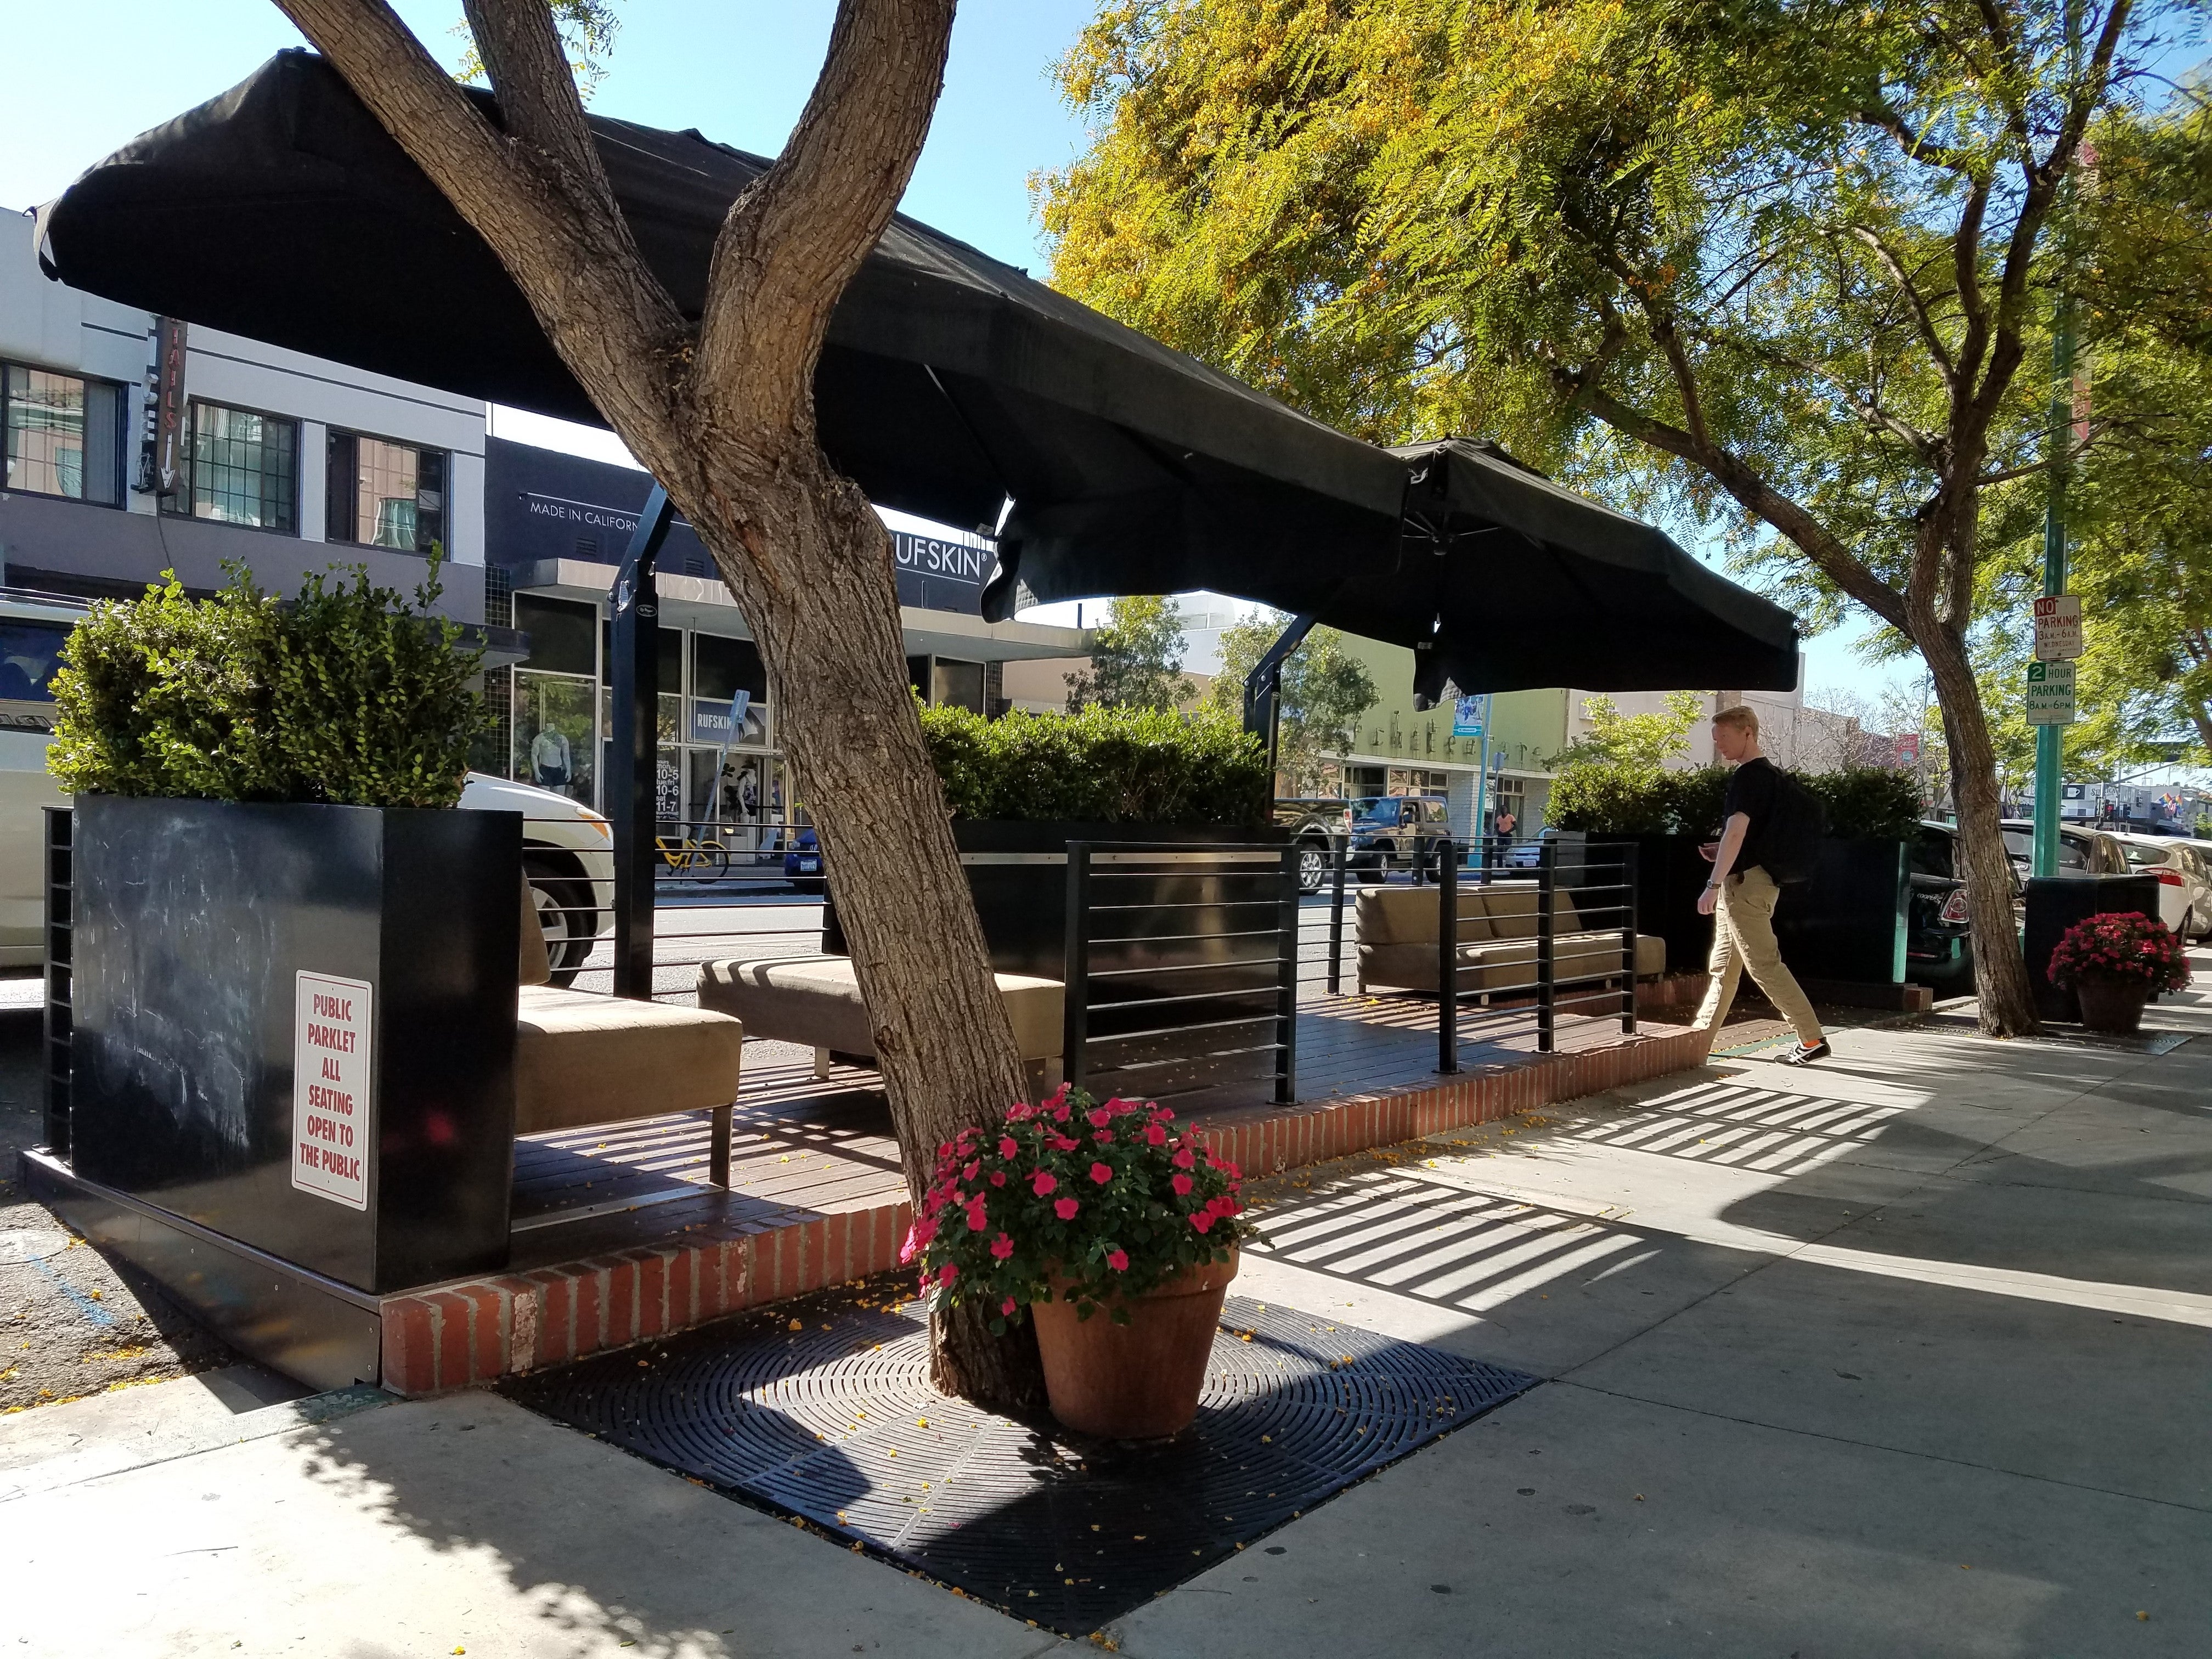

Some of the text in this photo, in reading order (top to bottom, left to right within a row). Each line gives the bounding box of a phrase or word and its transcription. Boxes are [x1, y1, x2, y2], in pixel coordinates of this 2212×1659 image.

[165, 318, 181, 430] TAILS
[530, 501, 565, 518] MADE
[569, 508, 581, 521] IN
[2036, 600, 2054, 615] NO
[2038, 614, 2078, 630] PARKING
[2032, 665, 2072, 679] 2 HOUR
[2032, 684, 2071, 697] PARKING
[657, 769, 679, 780] 10-5
[656, 785, 679, 796] 10-6
[656, 801, 676, 812] 11-7
[313, 993, 352, 1022] PUBLIC
[308, 1023, 356, 1054] PARKLET
[321, 1057, 341, 1082] ALL
[308, 1084, 353, 1116] SEATING
[307, 1114, 353, 1148] OPEN TO
[300, 1142, 360, 1182] THE PUBLIC
